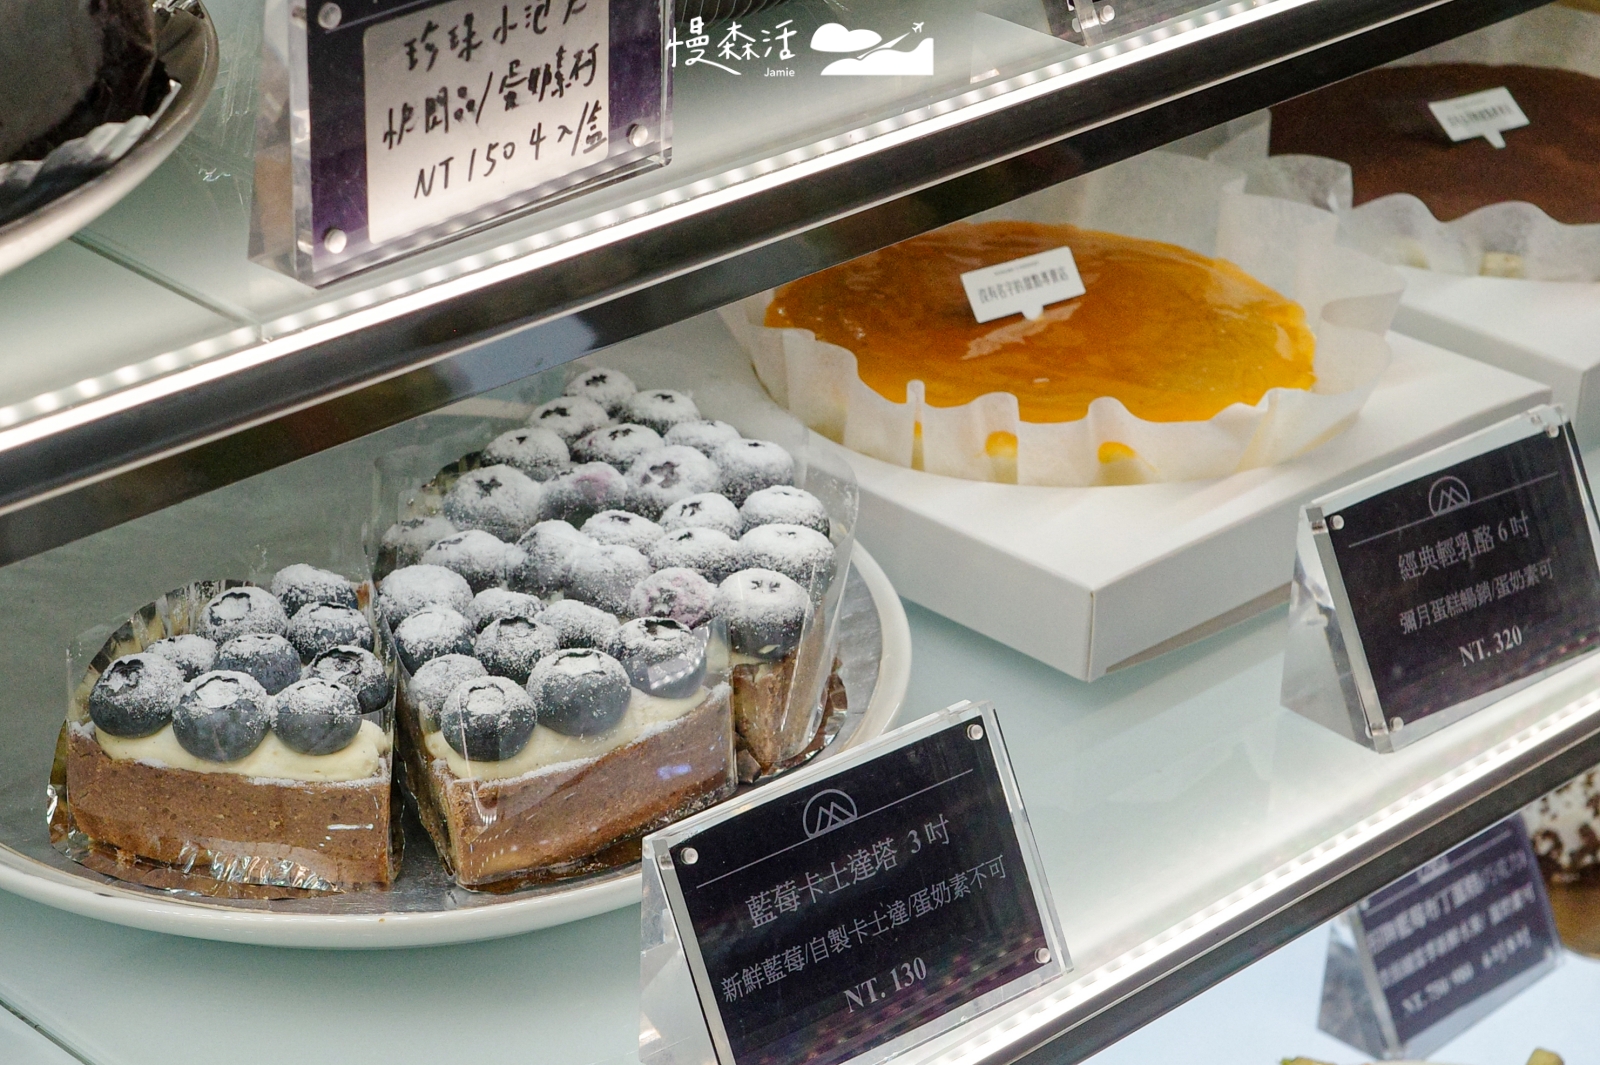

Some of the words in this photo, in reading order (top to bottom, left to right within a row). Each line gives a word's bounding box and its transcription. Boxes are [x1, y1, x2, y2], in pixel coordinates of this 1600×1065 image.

[413, 157, 454, 199] NT
[1496, 624, 1522, 656] 320
[746, 838, 897, 929] 藍莓卡士達塔
[842, 977, 887, 1014] NT.
[890, 956, 927, 993] 130
